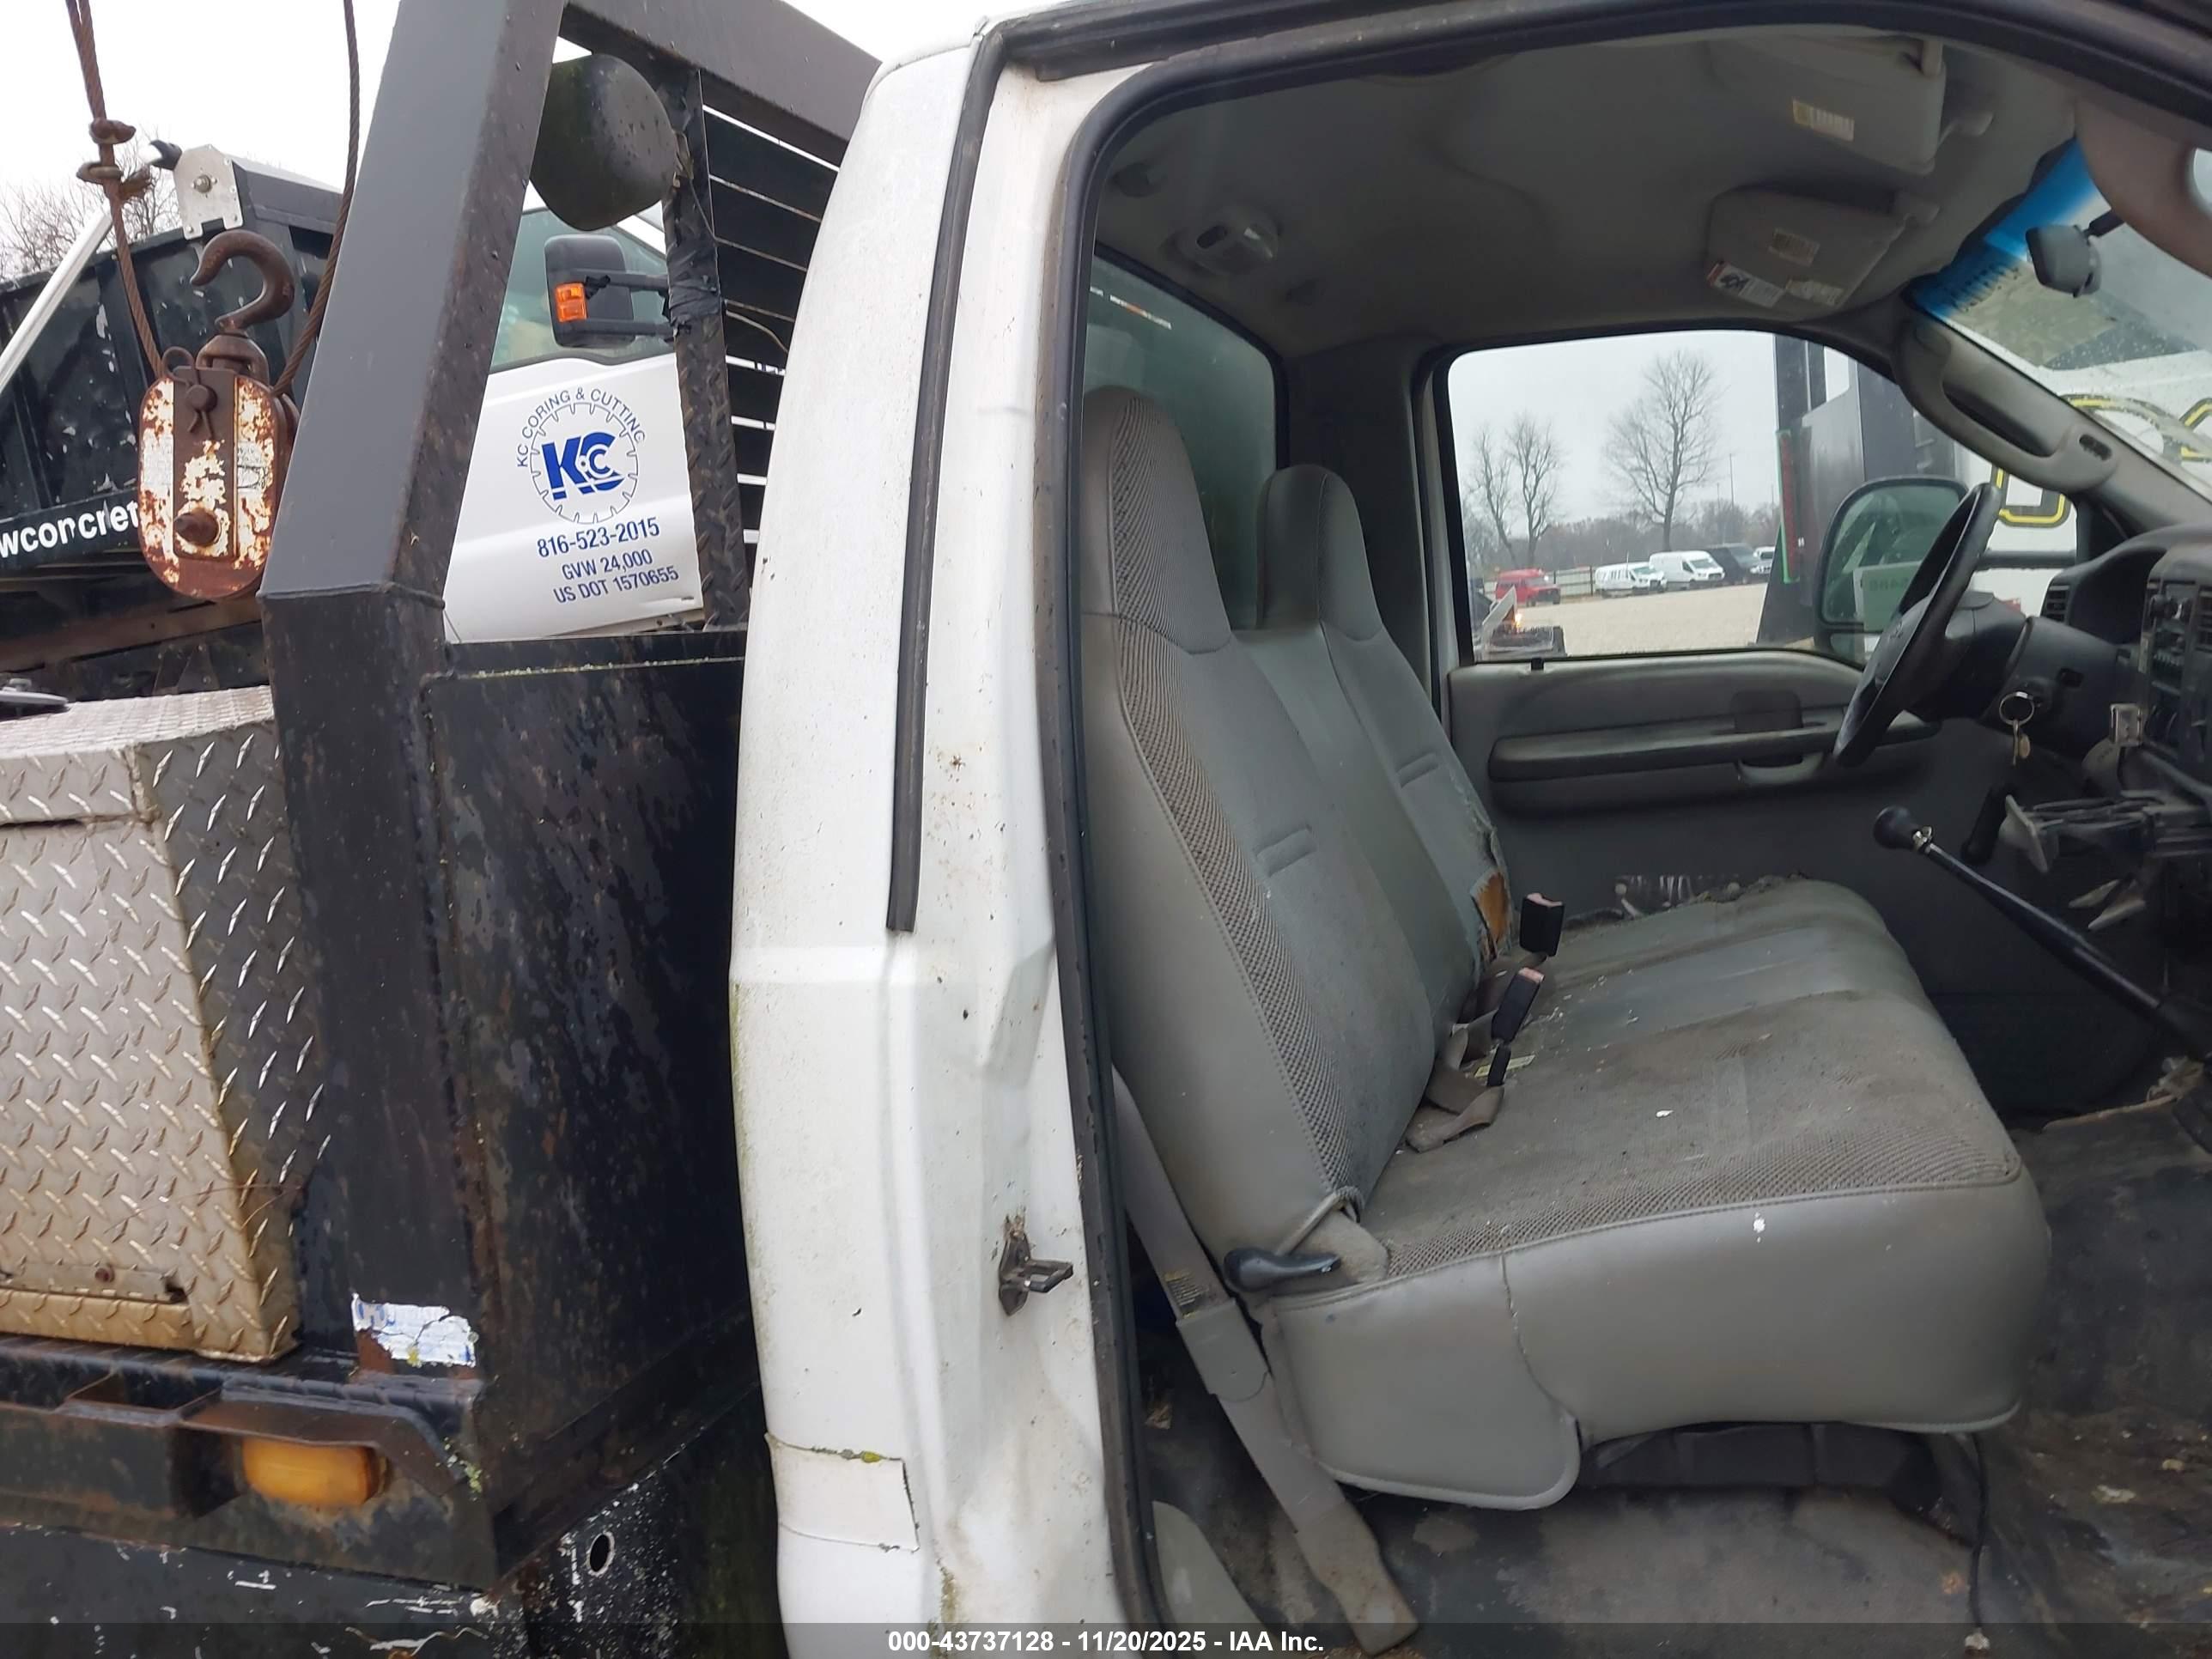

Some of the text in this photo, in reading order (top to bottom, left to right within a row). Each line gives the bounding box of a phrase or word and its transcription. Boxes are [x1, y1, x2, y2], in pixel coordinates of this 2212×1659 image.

[517, 387, 645, 467] KC CORING & CUTTING
[537, 517, 660, 557] 816-523-2015
[562, 549, 653, 580] GVW 24,000
[553, 566, 679, 604] US DOT 1570655
